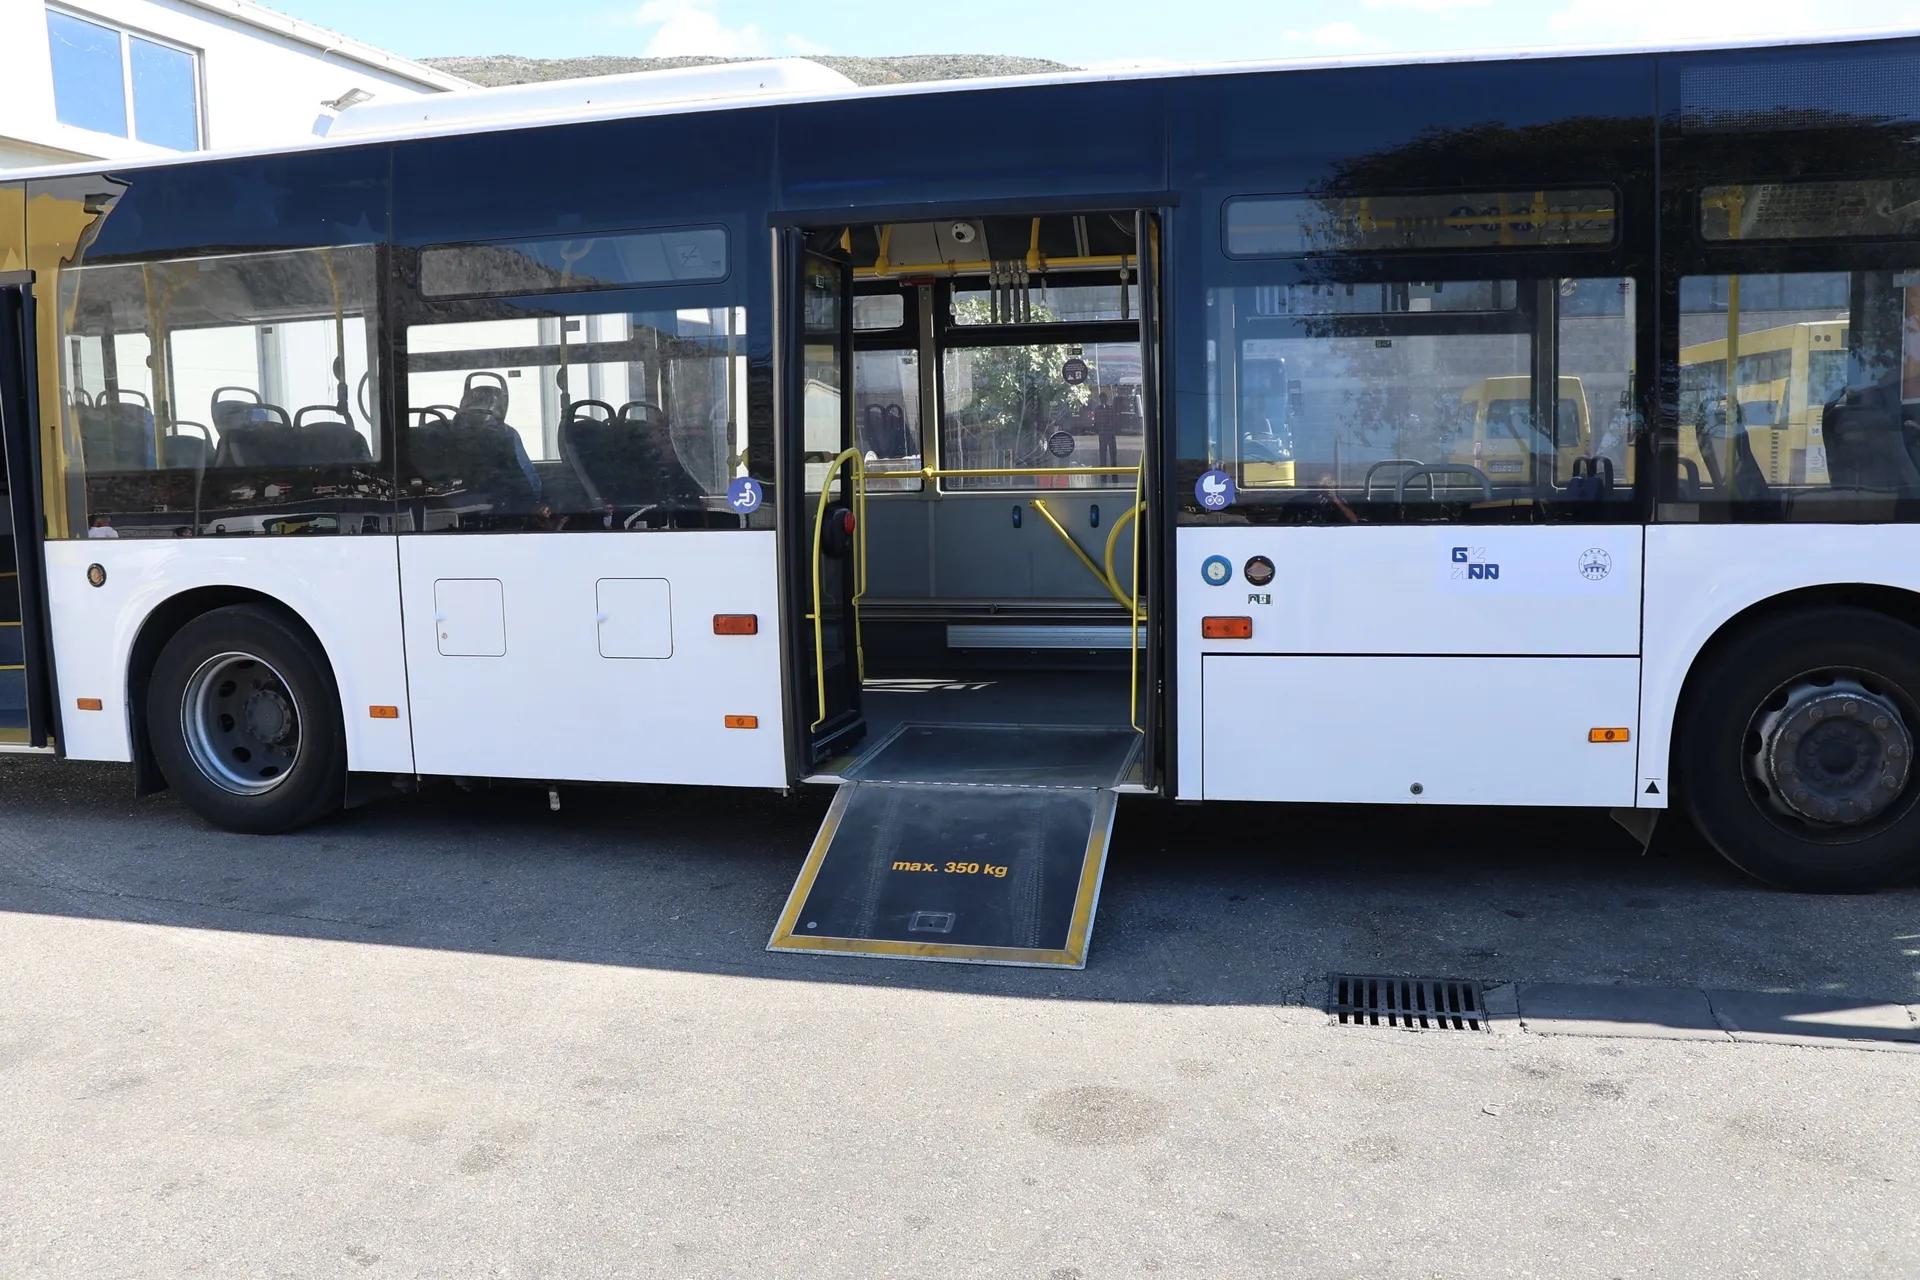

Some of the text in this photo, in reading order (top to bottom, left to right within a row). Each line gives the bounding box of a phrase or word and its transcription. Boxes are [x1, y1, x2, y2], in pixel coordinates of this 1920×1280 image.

[892, 861, 1008, 878] max. 350 kg
